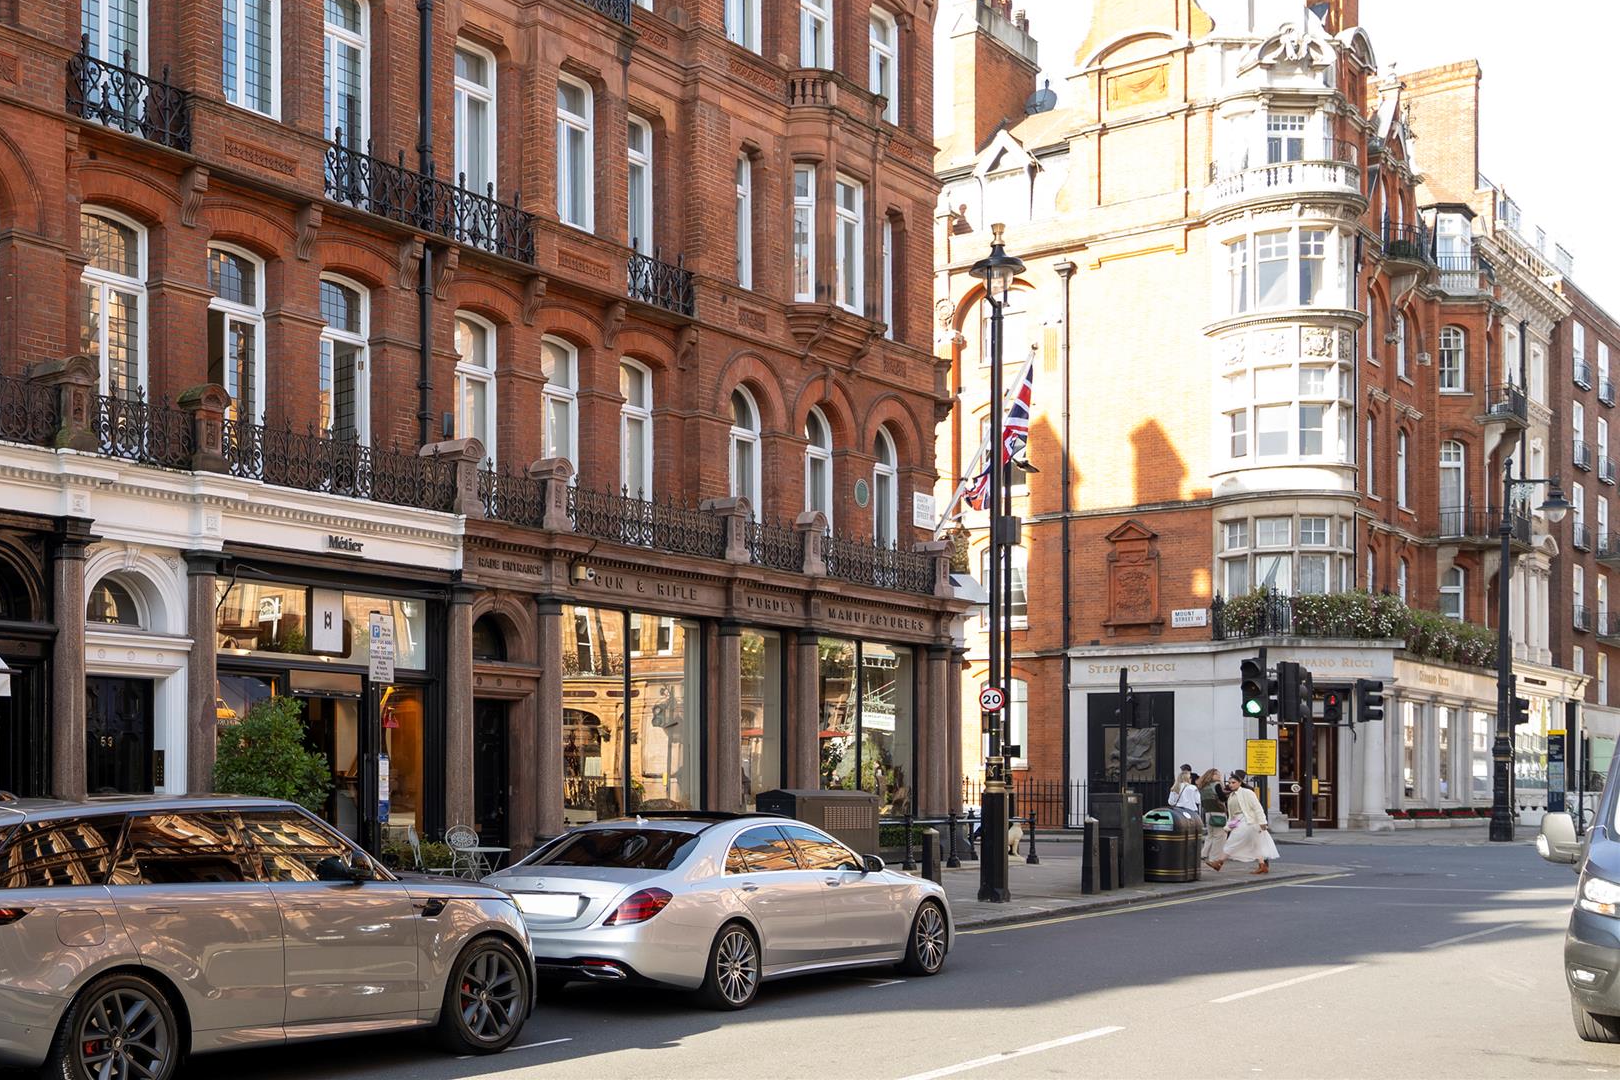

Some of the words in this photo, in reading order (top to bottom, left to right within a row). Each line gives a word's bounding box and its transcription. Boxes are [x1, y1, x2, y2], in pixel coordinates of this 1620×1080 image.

[328, 534, 364, 552] Métier
[502, 560, 543, 576] ENTRANCE
[594, 574, 623, 590] GUN
[636, 579, 645, 593] &
[657, 583, 697, 601] RIFLE
[747, 596, 797, 613] PURDEY
[828, 607, 925, 632] MANUFACTURERS
[1142, 661, 1177, 672] RICCI
[1341, 657, 1374, 668] RICCI
[982, 694, 1001, 705] 20
